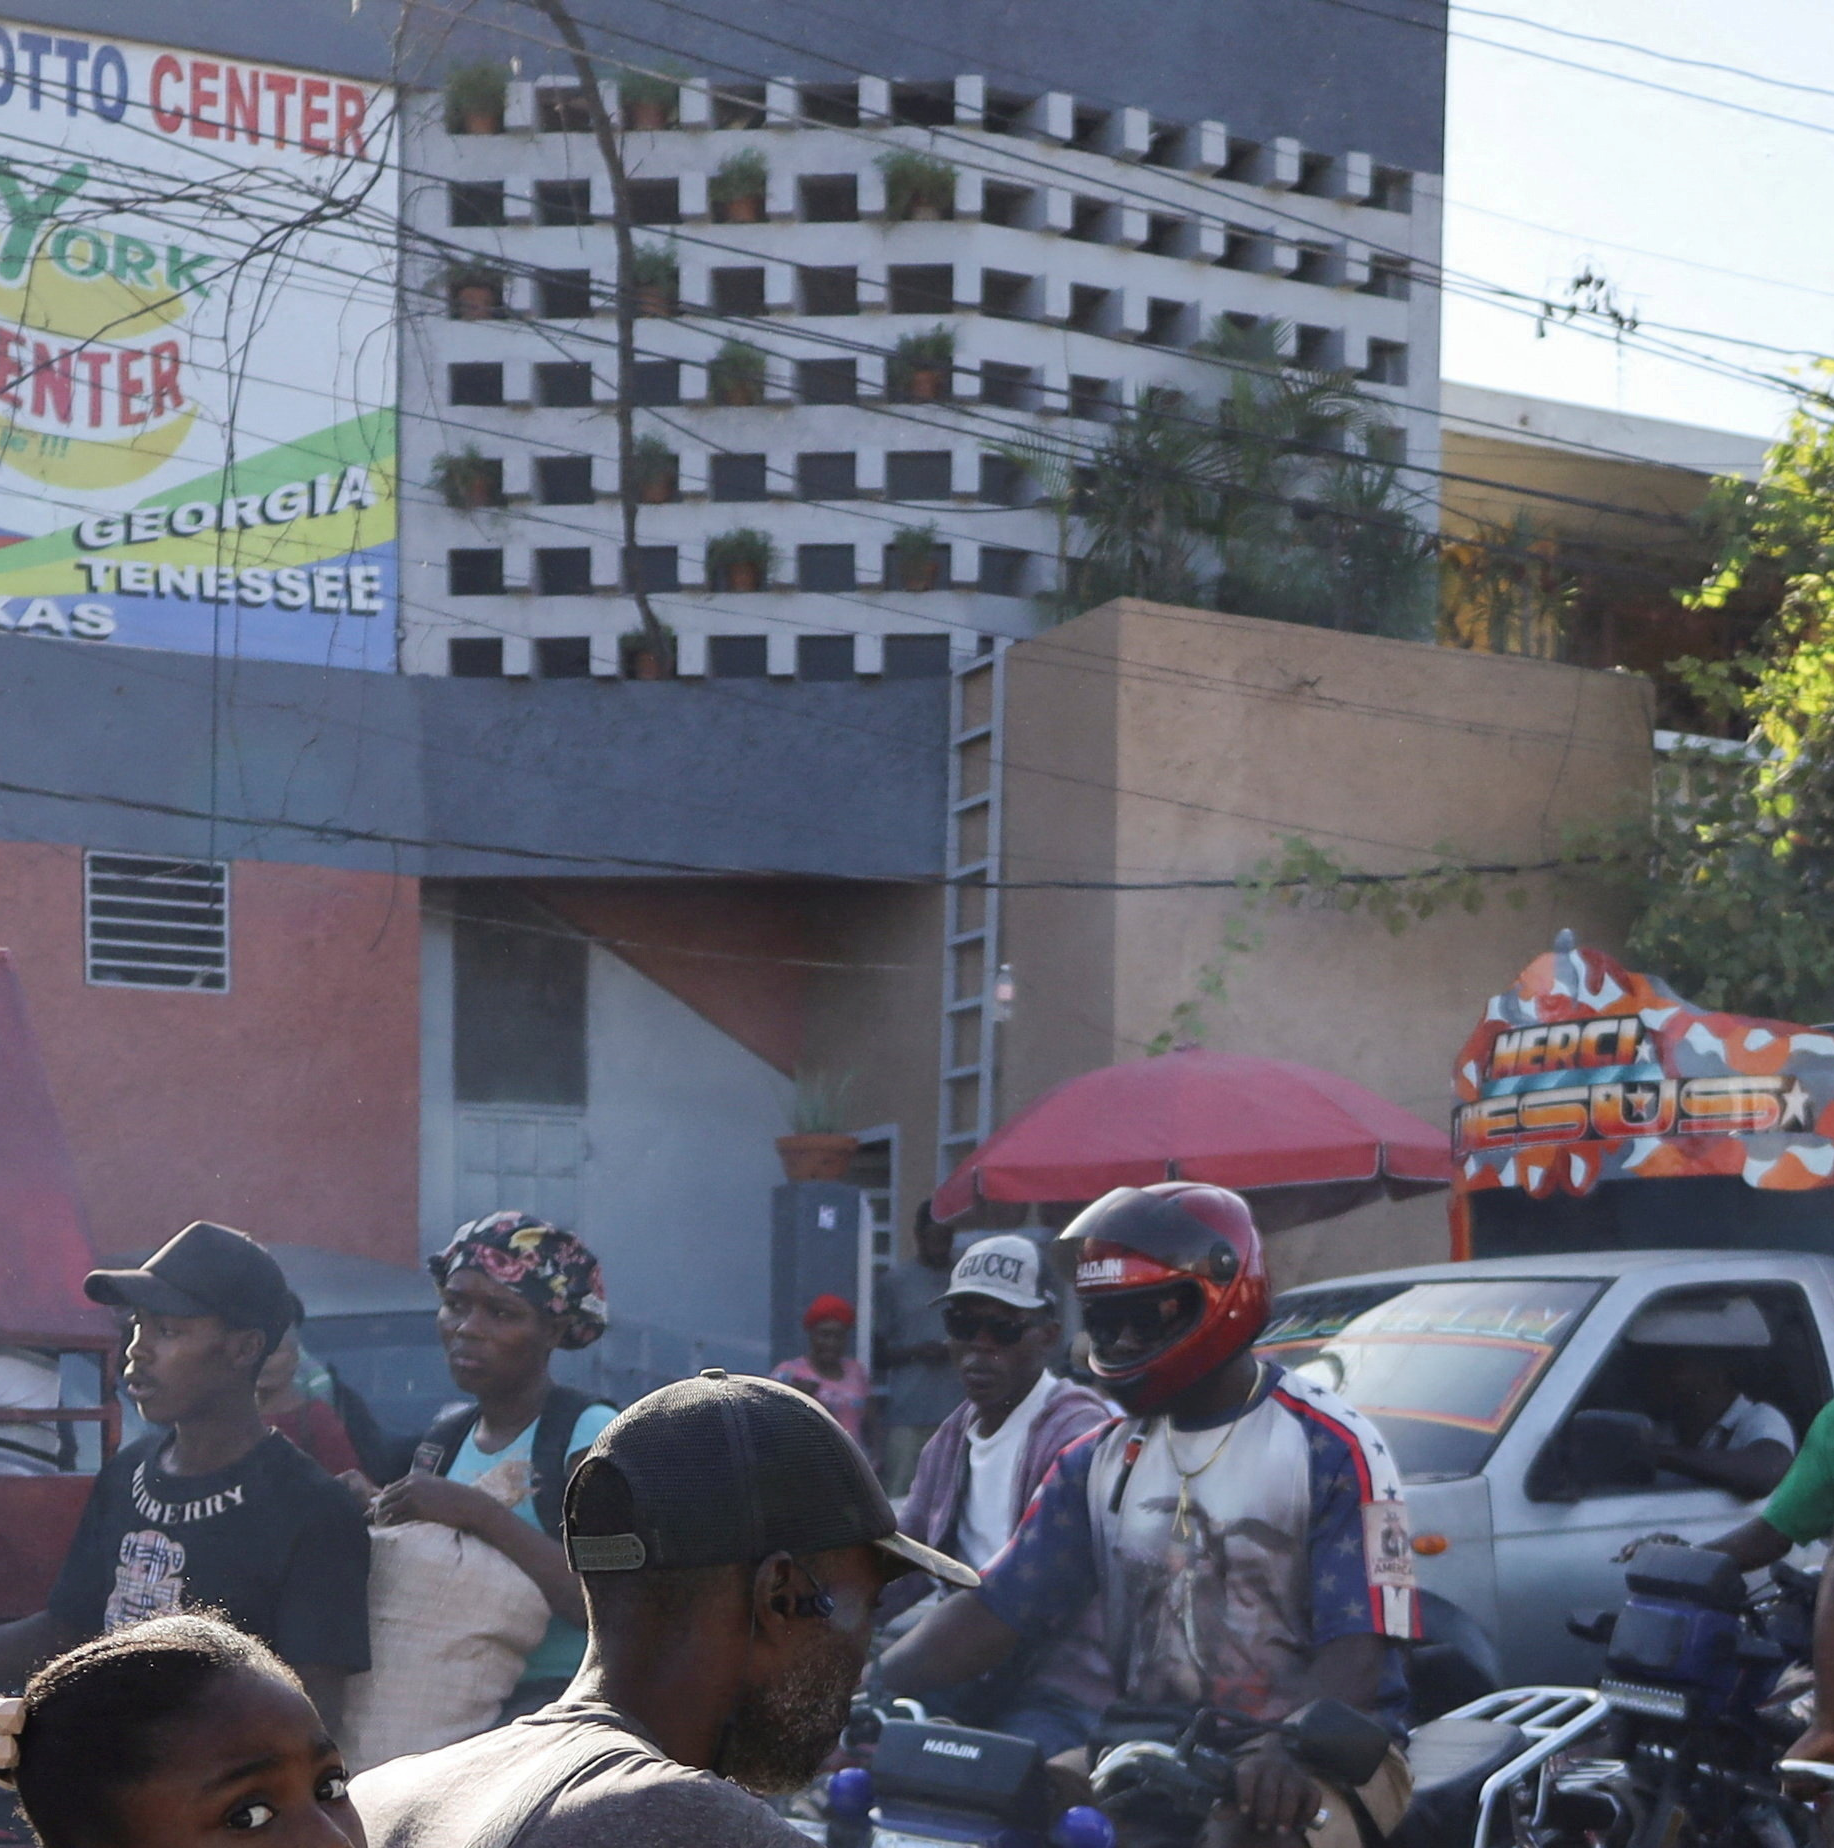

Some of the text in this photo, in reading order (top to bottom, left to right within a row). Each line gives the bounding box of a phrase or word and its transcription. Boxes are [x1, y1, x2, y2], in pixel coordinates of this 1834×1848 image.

[149, 54, 368, 160] CENTER
[76, 463, 376, 552] GEORGIA
[77, 556, 384, 616] TENESSEE
[1489, 1016, 1640, 1081] MERCI
[957, 1253, 1025, 1285] GUCCI
[132, 1460, 245, 1525] BURBERRY
[922, 1739, 982, 1760] HAOJIN
